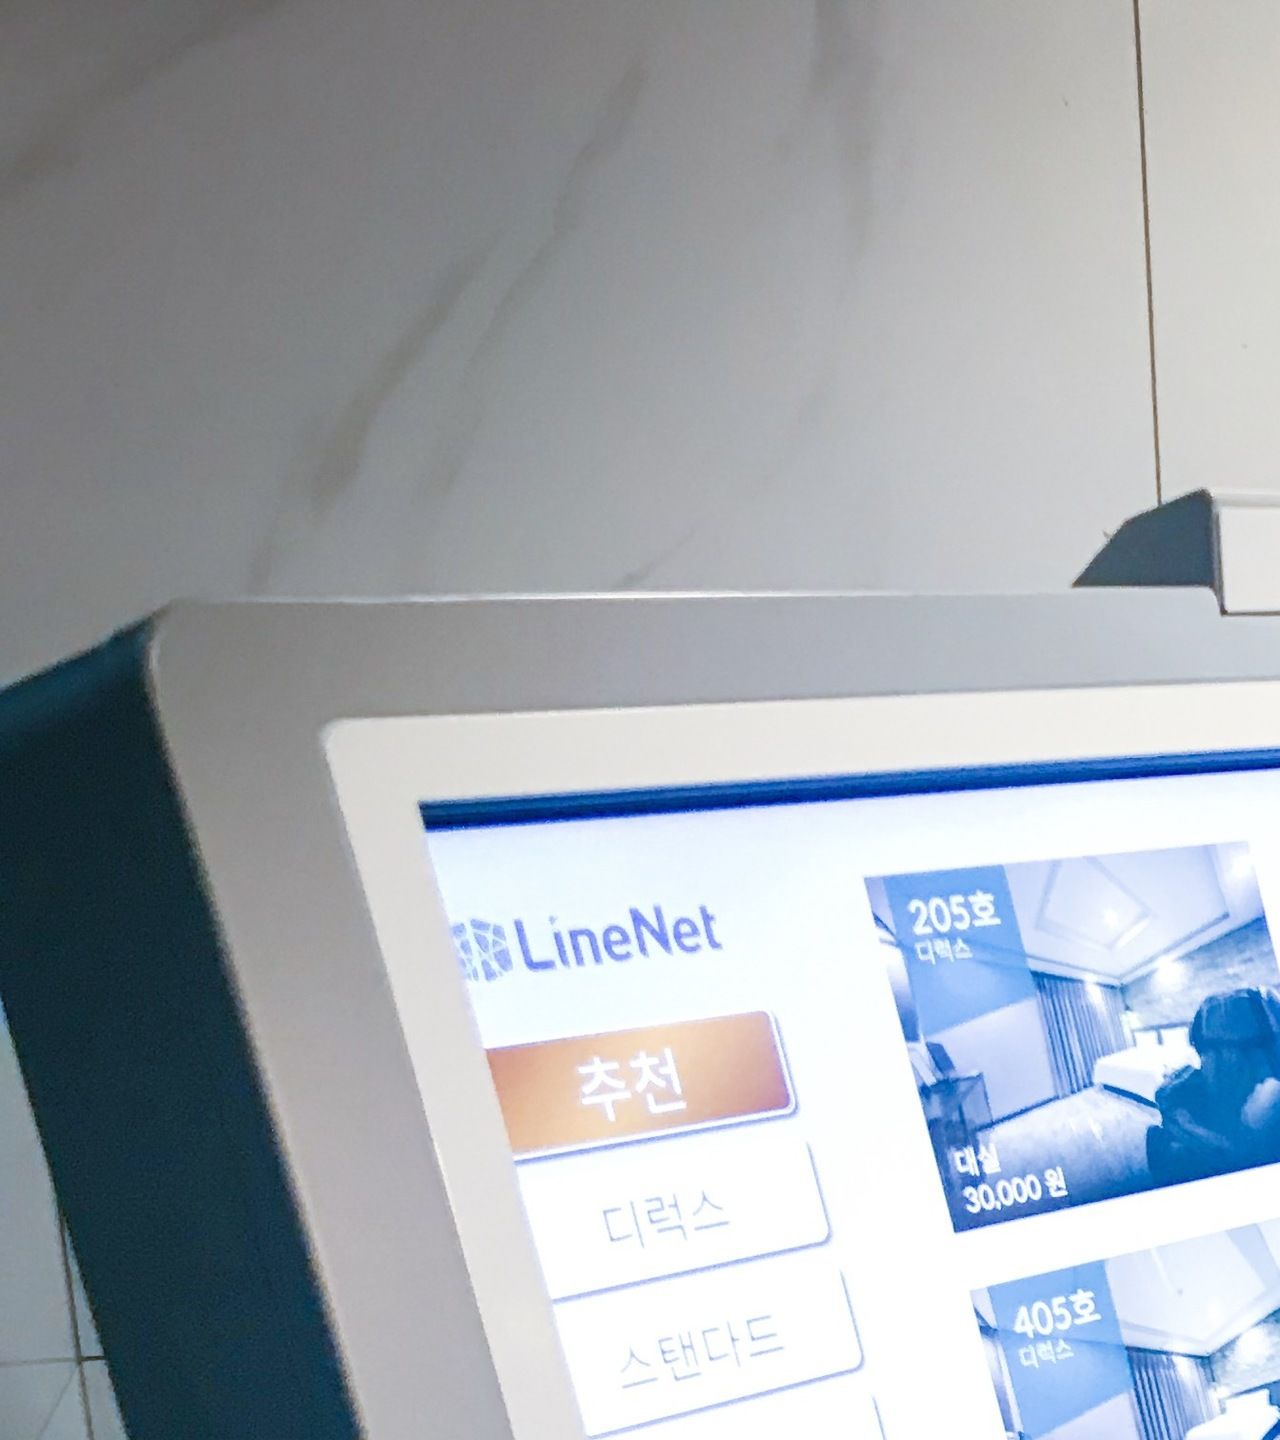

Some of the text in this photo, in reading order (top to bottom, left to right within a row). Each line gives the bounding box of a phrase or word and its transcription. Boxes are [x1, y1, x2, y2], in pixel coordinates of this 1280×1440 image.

[519, 904, 723, 972] LineNet
[908, 890, 1002, 934] 205호
[576, 1047, 687, 1123] 추천
[602, 1190, 732, 1249] 디럭스
[963, 1175, 1043, 1215] 30,000
[1014, 1289, 1102, 1341] 405호
[618, 1312, 785, 1390] 스탠다드
